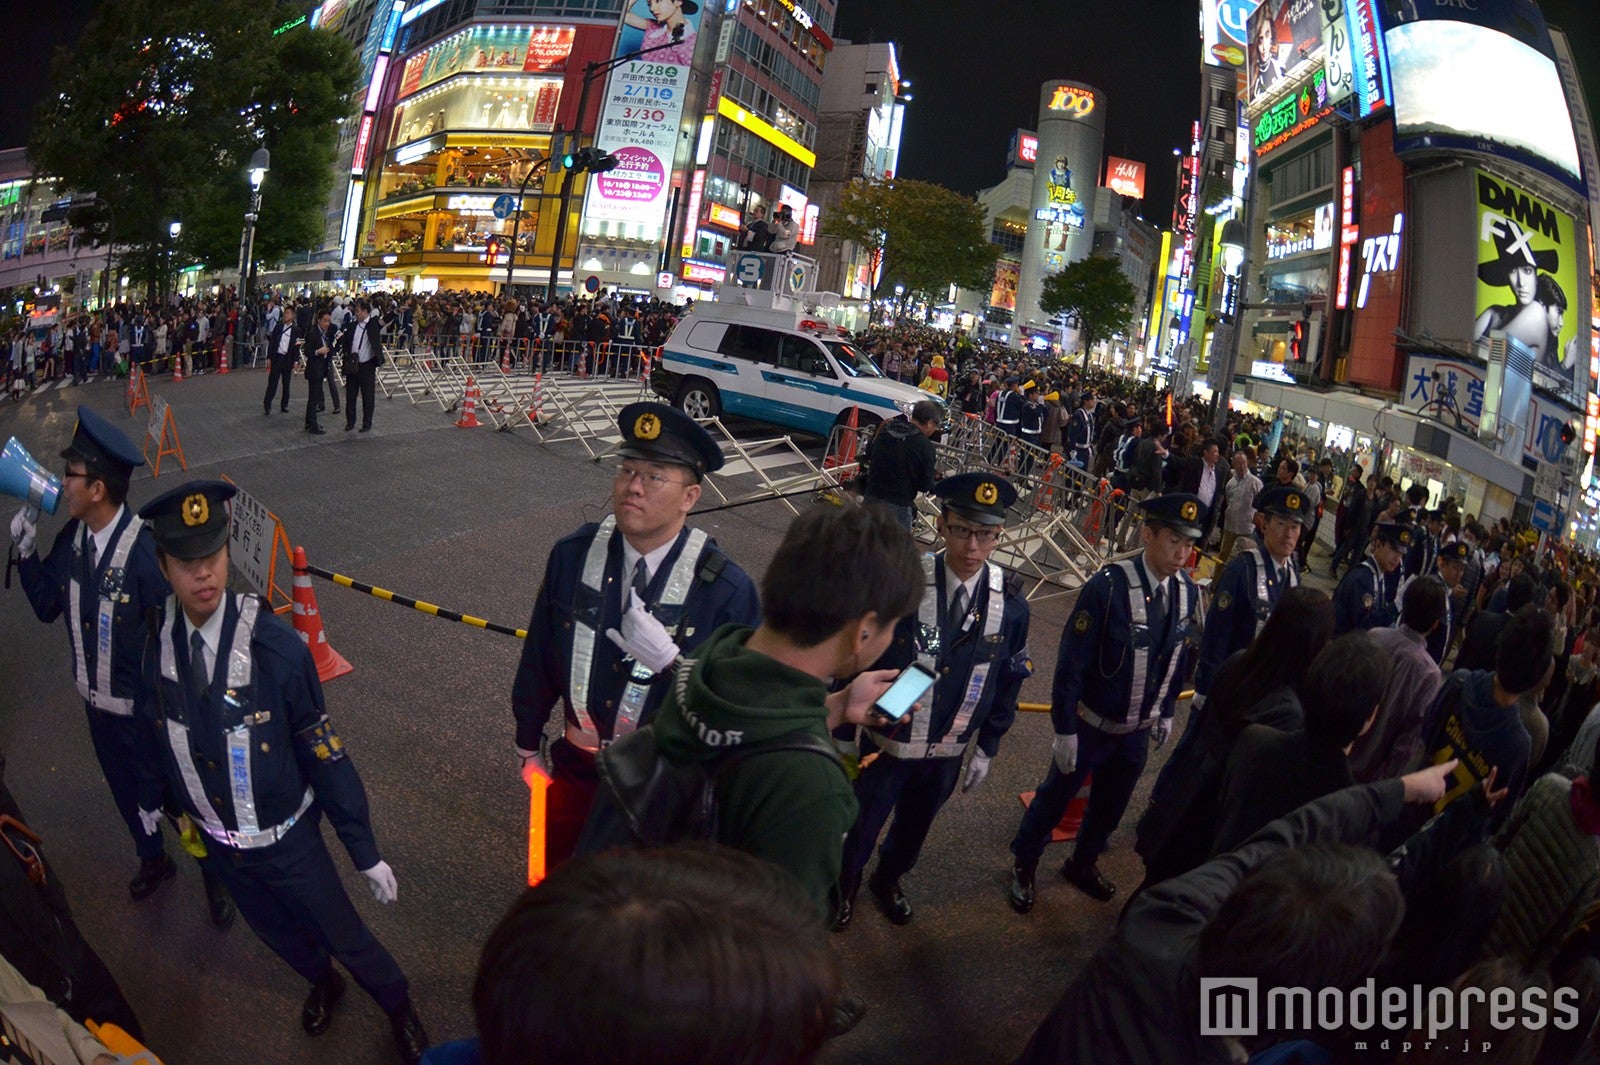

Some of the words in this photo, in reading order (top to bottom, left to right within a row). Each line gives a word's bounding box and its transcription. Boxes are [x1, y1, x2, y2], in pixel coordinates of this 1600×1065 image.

[612, 95, 677, 108] 神奈川県民ホール
[1057, 85, 1095, 99] SHIBUYA
[1048, 91, 1096, 118] 109
[605, 118, 675, 132] 東京国際フォーラム
[1477, 142, 1495, 153] DHC
[1115, 162, 1138, 179] H&M
[1178, 156, 1191, 230] KATE
[1478, 173, 1561, 245] DMM
[1268, 236, 1312, 259] Euphoria
[1481, 211, 1536, 267] FX
[741, 258, 761, 282] 3
